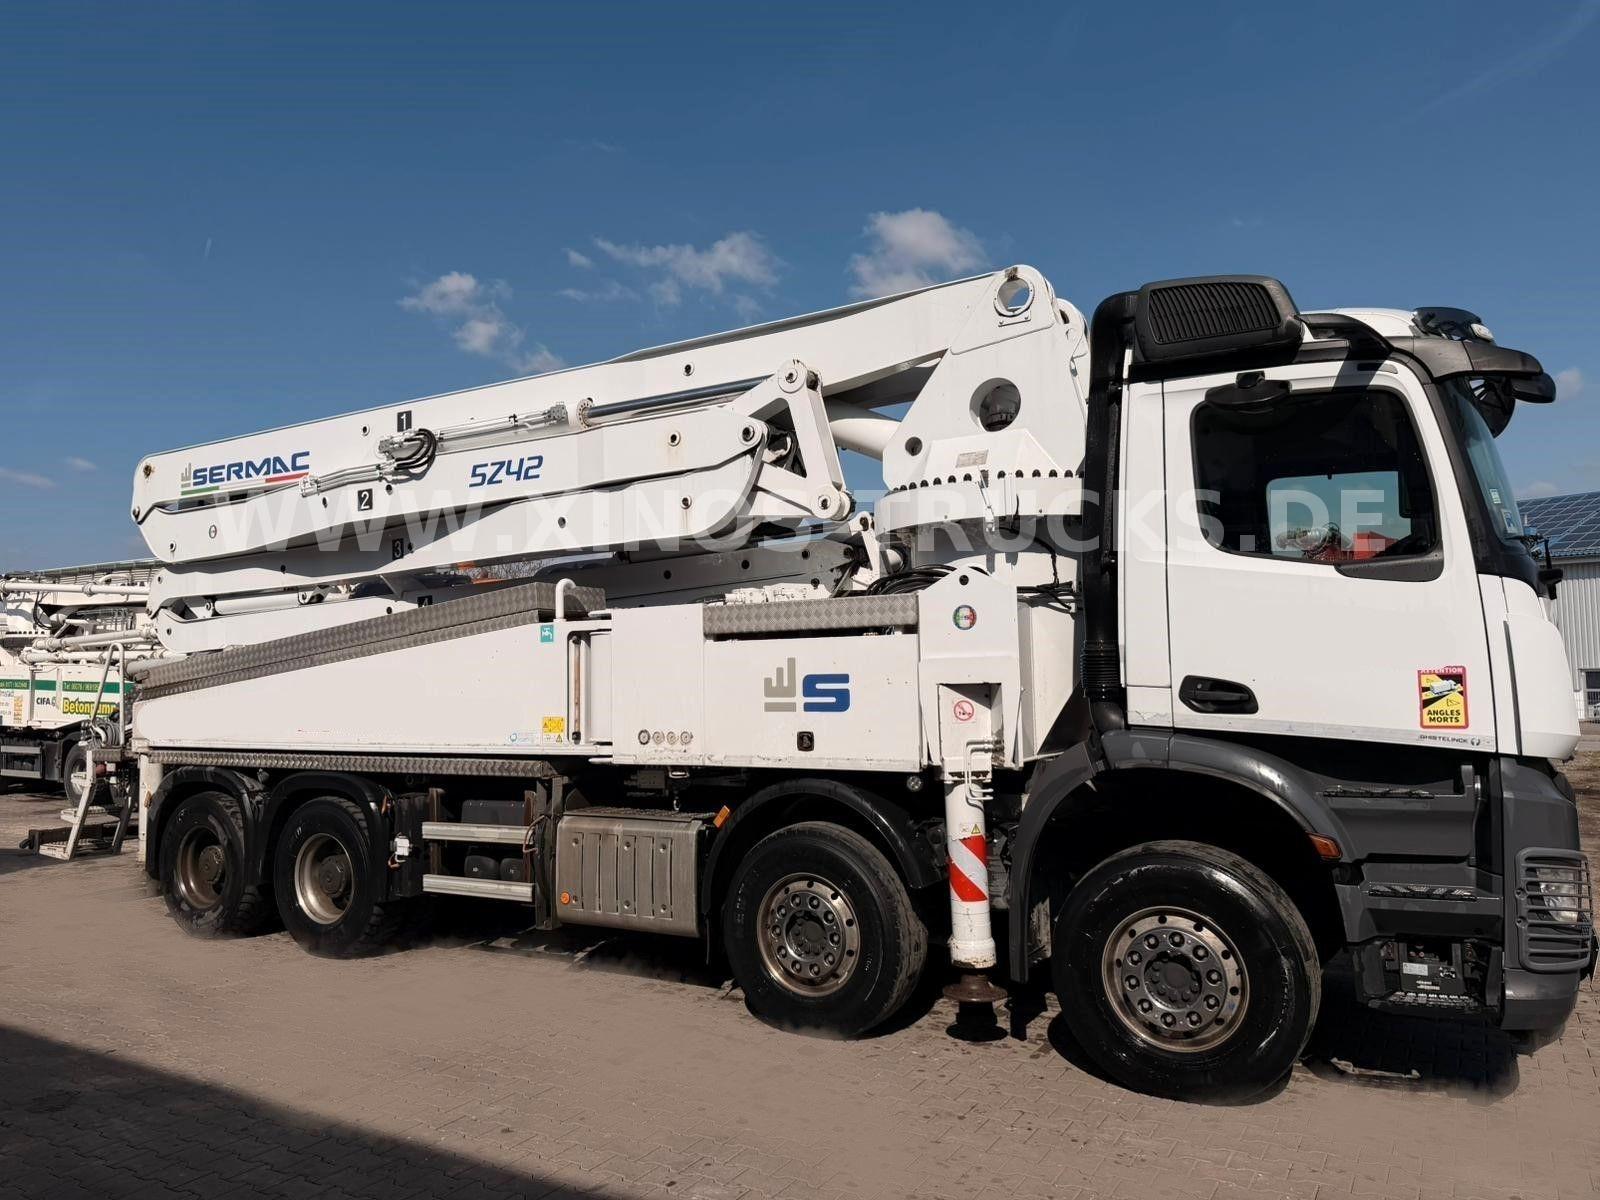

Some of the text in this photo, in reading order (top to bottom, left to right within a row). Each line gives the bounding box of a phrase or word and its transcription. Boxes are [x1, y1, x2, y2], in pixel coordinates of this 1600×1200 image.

[192, 451, 310, 486] SERMAC
[360, 490, 370, 510] 2
[394, 541, 403, 559] 3
[36, 697, 50, 705] CIFA
[62, 698, 117, 716] Betonpm
[1427, 709, 1461, 717] ANGLES
